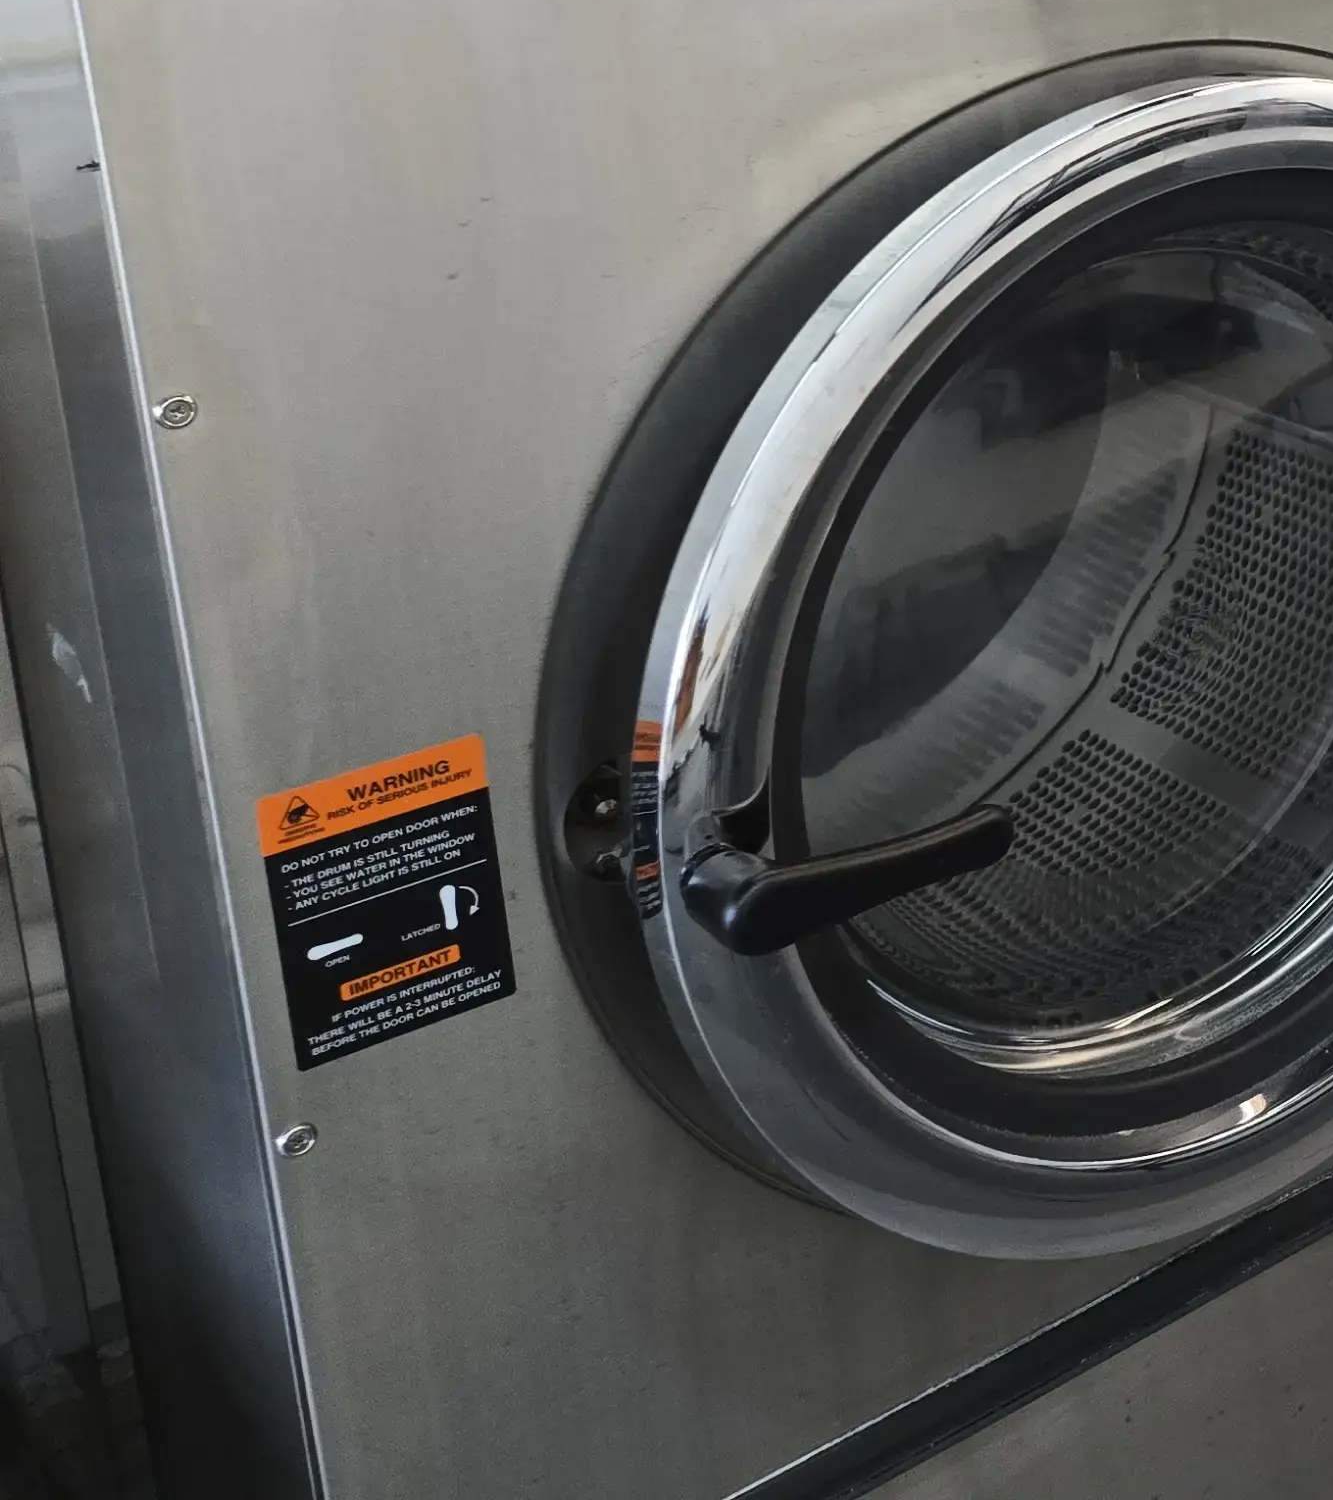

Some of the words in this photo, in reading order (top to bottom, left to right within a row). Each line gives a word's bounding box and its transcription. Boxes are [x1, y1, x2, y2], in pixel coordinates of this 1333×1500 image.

[326, 805, 356, 820] RISK
[357, 799, 373, 811] OF
[376, 782, 429, 805] SERIOUS
[431, 768, 472, 788] INJURY
[347, 760, 450, 802] WARNING
[281, 861, 299, 873] DO
[301, 852, 326, 867] NOT
[327, 844, 351, 858] TRY
[353, 839, 369, 850] TO
[372, 828, 403, 844] OPEN
[406, 816, 439, 834] DOOR
[440, 805, 477, 822] WHEN:
[291, 873, 315, 887] THE
[317, 862, 351, 879] DRUM
[353, 857, 365, 867] IS
[366, 848, 399, 863] STILL
[399, 830, 450, 852] TURNING
[292, 884, 318, 898] YOU
[320, 876, 344, 890] SEE
[345, 862, 387, 881] WATER
[389, 857, 401, 867] IN
[402, 849, 425, 862] THE
[427, 833, 475, 854] WINDOW
[295, 895, 319, 910] ANY
[322, 882, 360, 901] CYCLE
[362, 870, 395, 888] LIGHT
[397, 866, 409, 876] IS
[411, 856, 442, 871] STILL
[443, 849, 461, 860] ON
[401, 923, 441, 941] LATCHED
[325, 955, 350, 967] OPEN
[349, 949, 451, 996] IMPORTANT
[307, 1026, 346, 1045] THERE
[347, 1016, 375, 1031] WILL
[377, 1008, 393, 1020] BE
[395, 1005, 403, 1014] A
[405, 999, 421, 1011] 2-3
[423, 983, 464, 1004] MINUTE
[466, 969, 501, 988] DELAY
[312, 1033, 357, 1056] BEFORE
[358, 1024, 380, 1038] THE
[382, 1012, 414, 1030] DOOR
[416, 1003, 439, 1017] CAN
[441, 997, 456, 1009] BE
[458, 981, 501, 1002] OPENED
[331, 1012, 342, 1023] IF
[344, 998, 385, 1018] POWER
[386, 993, 398, 1003] IS
[399, 966, 475, 999] INTERRUPTED:
